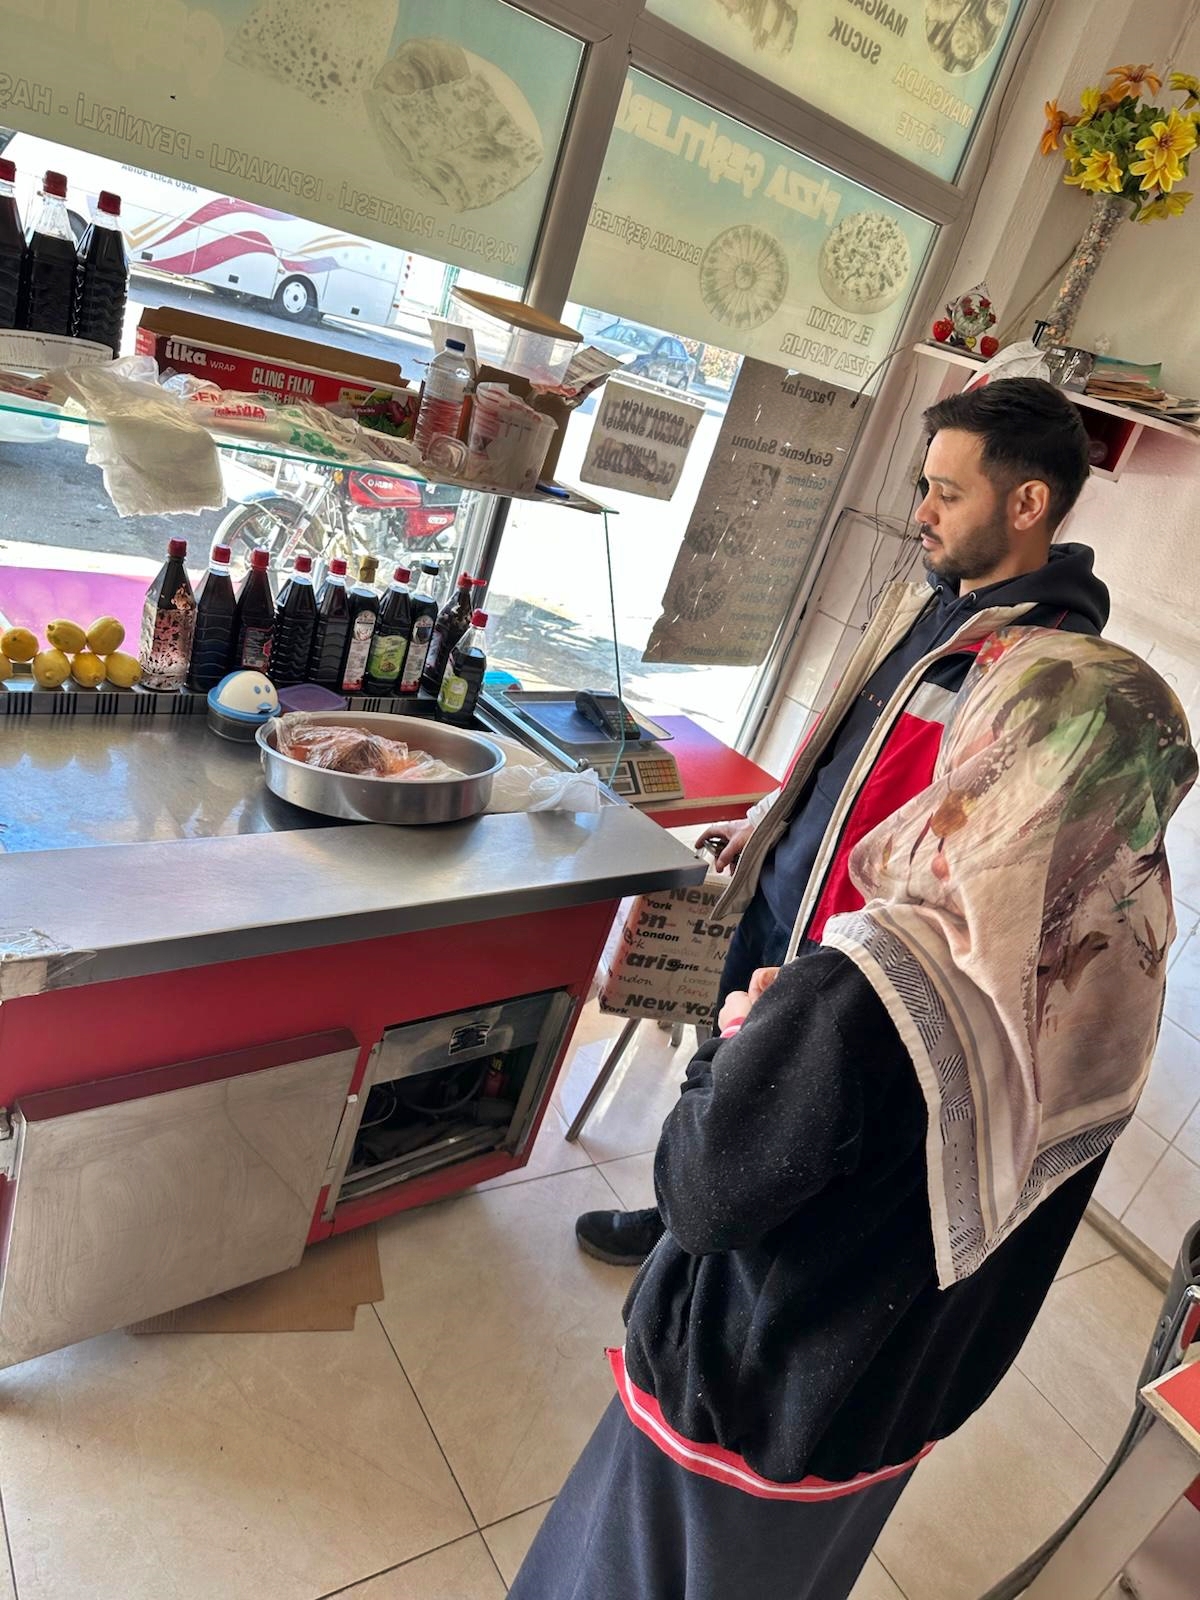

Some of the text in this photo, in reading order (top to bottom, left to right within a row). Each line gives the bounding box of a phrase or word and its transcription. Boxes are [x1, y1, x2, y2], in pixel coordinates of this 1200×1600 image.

[165, 341, 208, 366] ilka
[209, 360, 236, 373] WRAP
[252, 367, 315, 395] CLING FILM
[636, 928, 680, 942] London
[624, 993, 679, 1012] New
